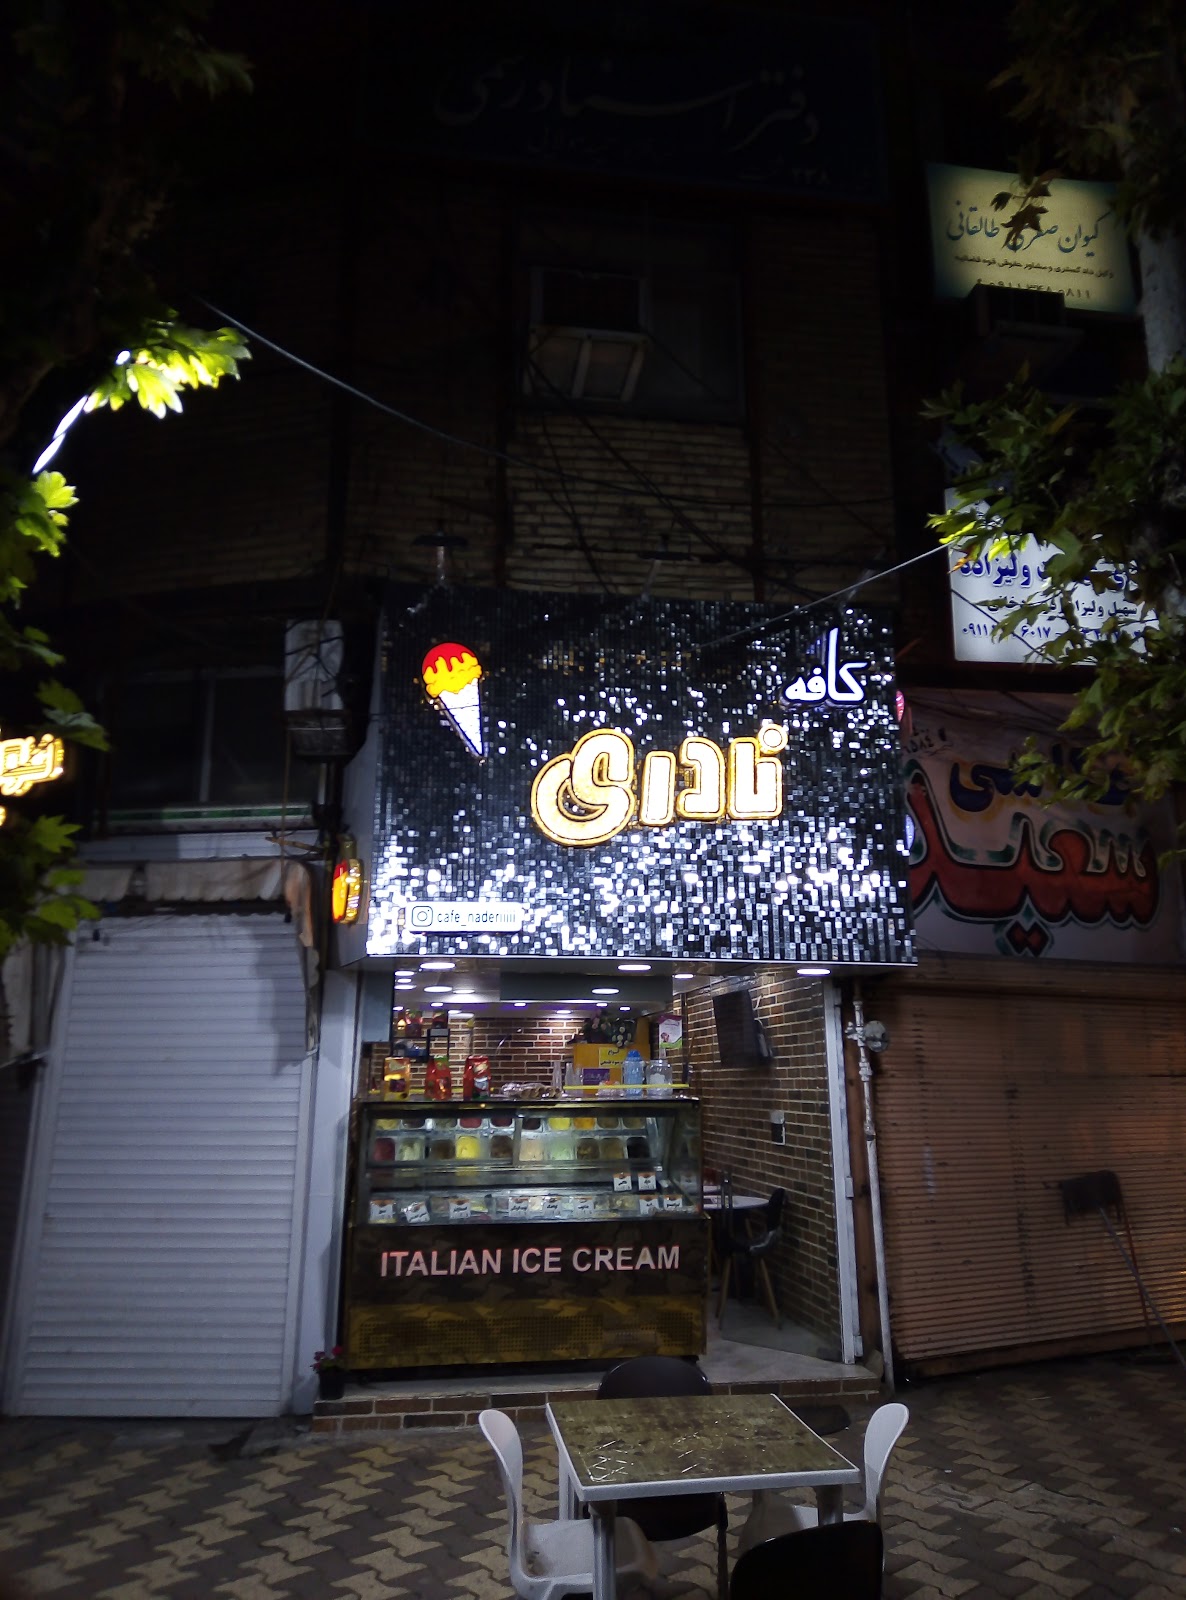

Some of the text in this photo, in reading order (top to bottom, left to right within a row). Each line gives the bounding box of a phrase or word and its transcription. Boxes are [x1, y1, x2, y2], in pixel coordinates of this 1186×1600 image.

[947, 200, 1000, 240] طالقانی
[1058, 211, 1111, 256] کیوان
[961, 553, 1031, 587] ولیزاده
[1075, 600, 1104, 617] ولیزا
[1108, 601, 1137, 617] سهیل
[962, 623, 1051, 639] ۰۹۱۱۶۰۱۷
[784, 627, 870, 706] کافه
[531, 725, 788, 846] نادری
[381, 1246, 679, 1278] ITALIAN ICE CREAM
